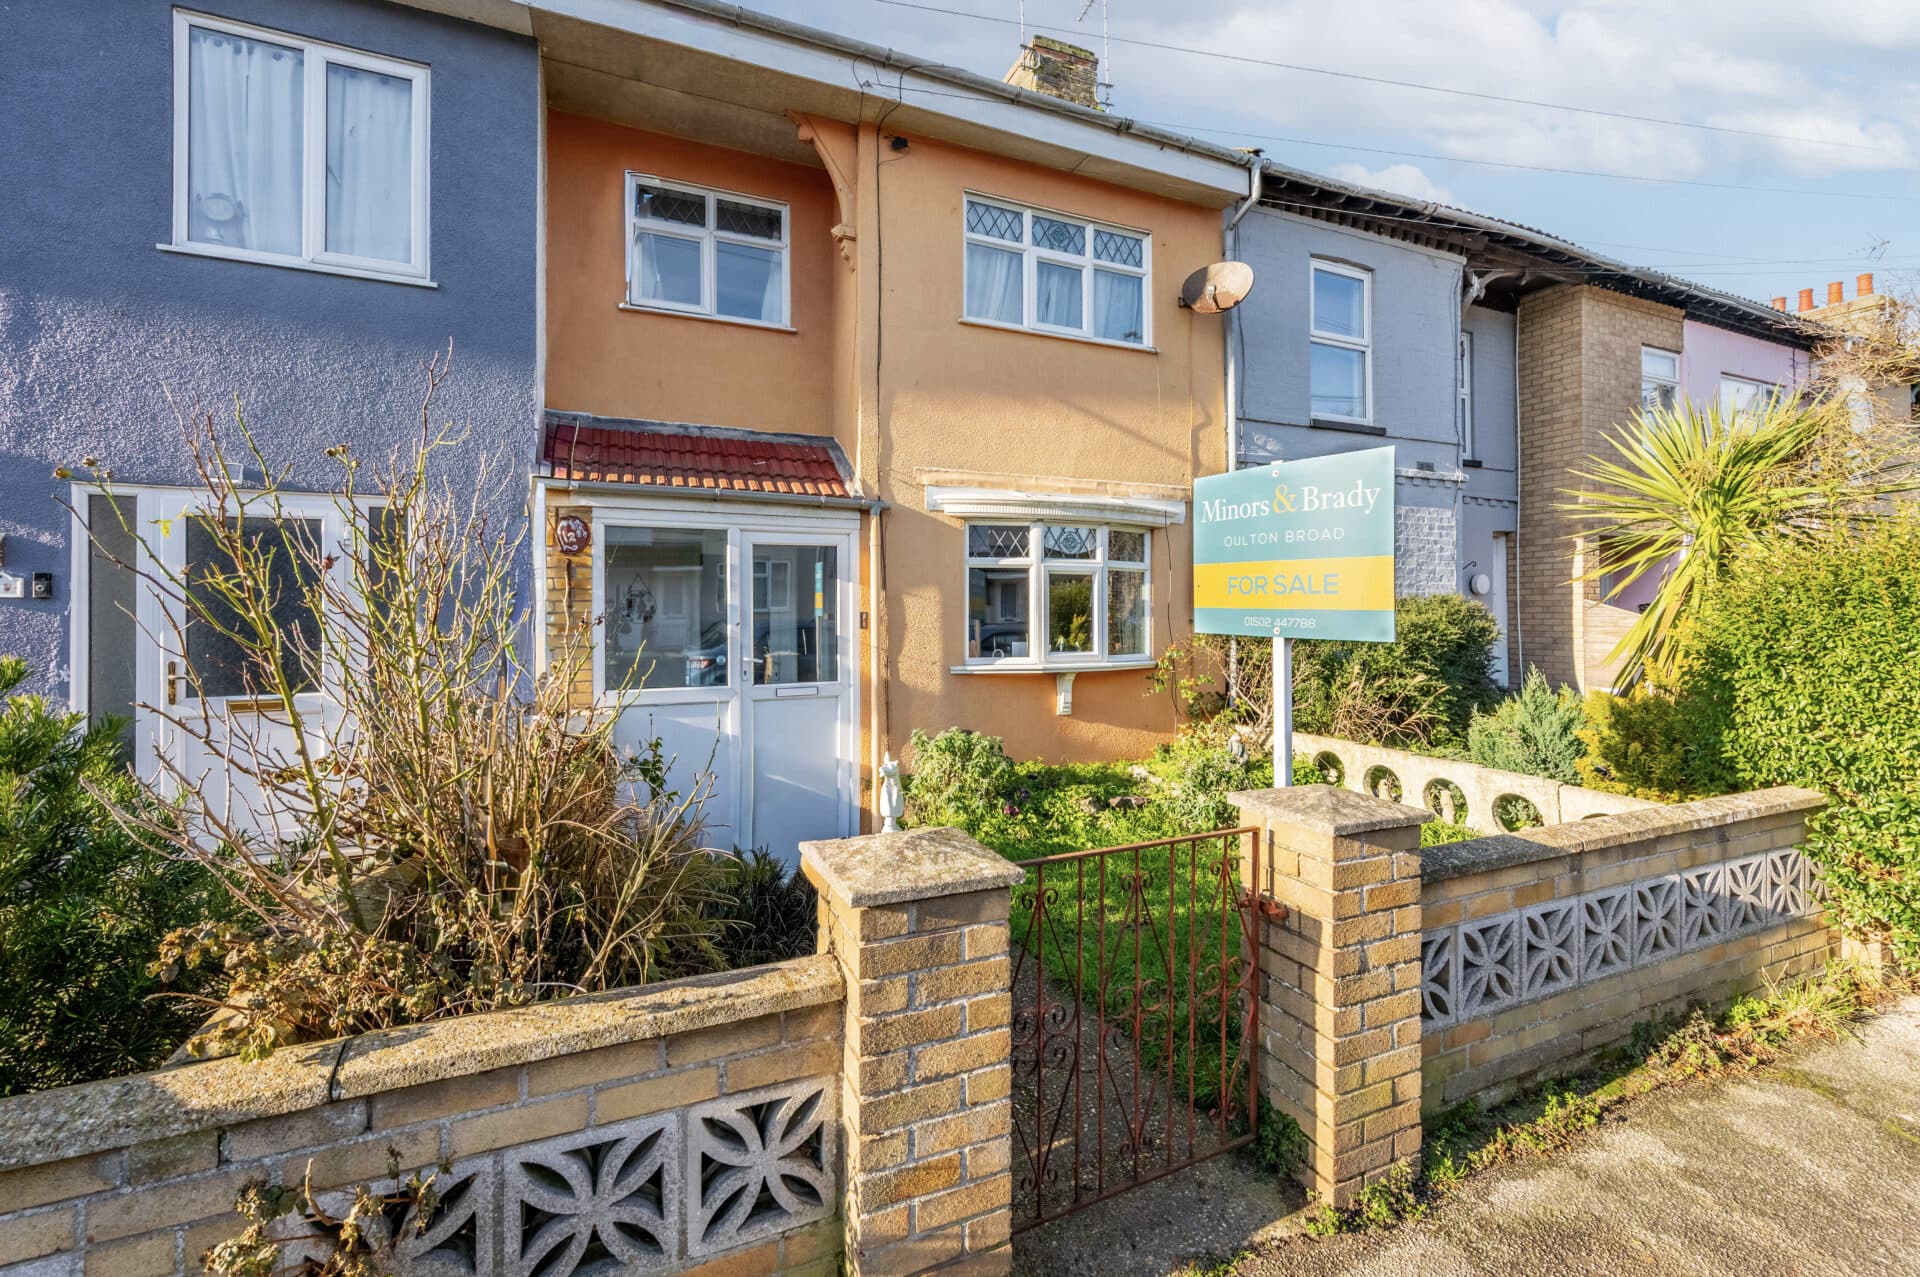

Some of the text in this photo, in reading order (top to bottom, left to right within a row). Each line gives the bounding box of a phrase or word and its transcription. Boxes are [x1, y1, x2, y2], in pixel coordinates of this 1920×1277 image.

[1201, 480, 1381, 523] Minors & Brady
[1224, 527, 1345, 547] OULTON BROAD
[1228, 573, 1339, 595] FOR SALE
[1244, 616, 1272, 627] 01502
